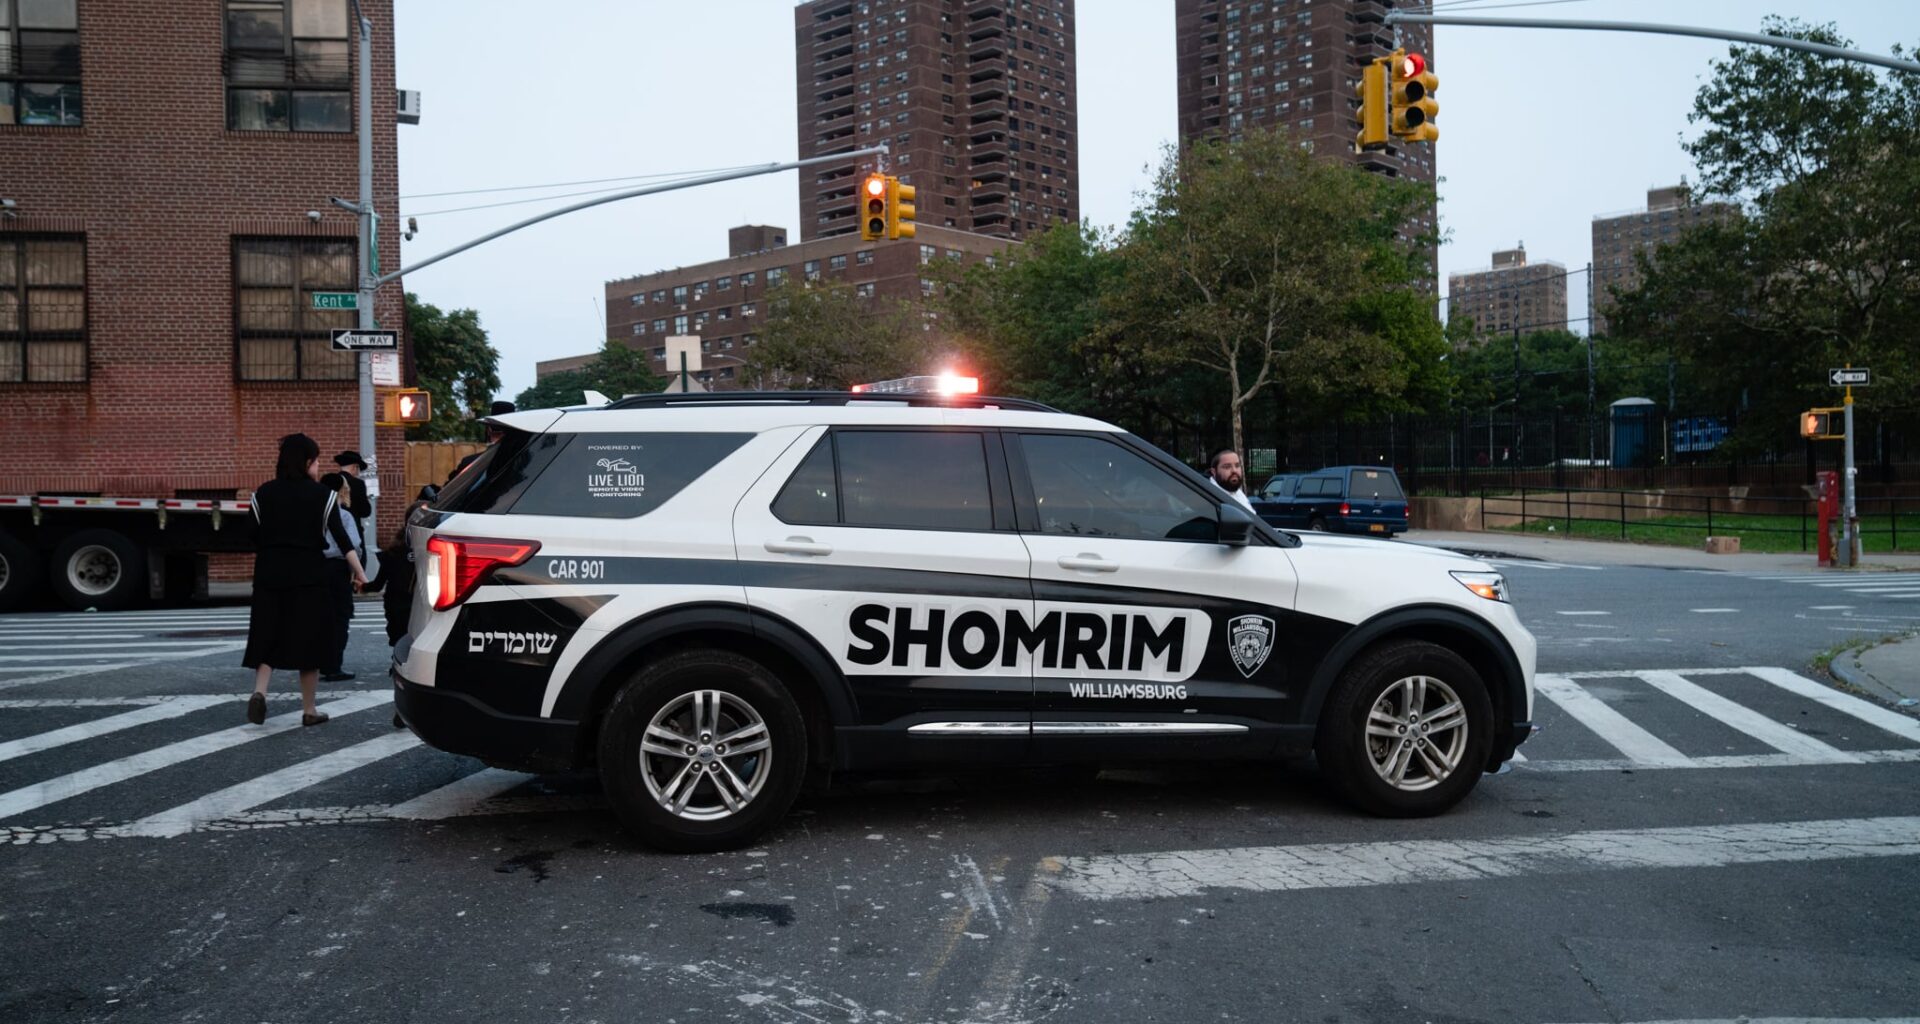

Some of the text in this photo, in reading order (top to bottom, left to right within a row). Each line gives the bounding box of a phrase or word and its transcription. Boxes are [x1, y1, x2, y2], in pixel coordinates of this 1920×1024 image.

[314, 295, 343, 307] Kent
[344, 335, 389, 344] ONE WAY
[588, 474, 644, 487] LIVE LION
[548, 559, 604, 579] CAR 901
[468, 630, 557, 654] שומרים
[846, 603, 1187, 673] SHOMRIM
[1069, 682, 1187, 700] WILLIAMSBURG
